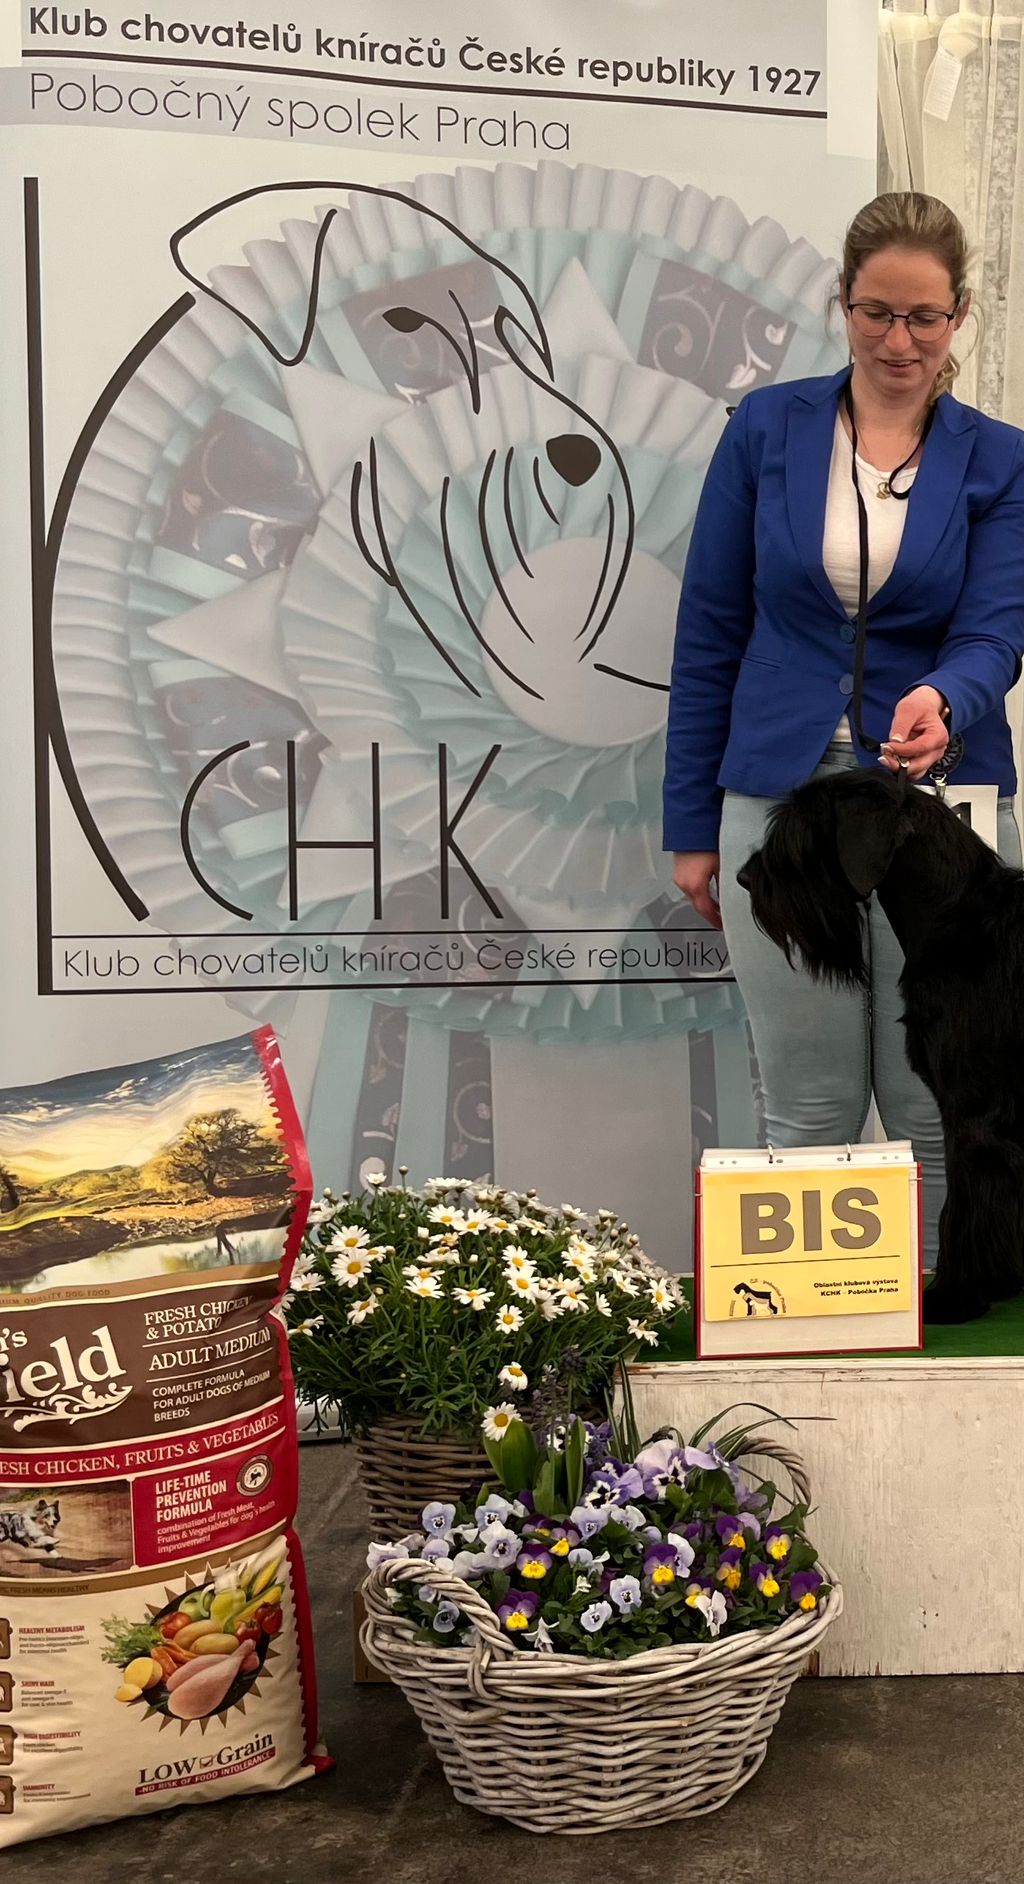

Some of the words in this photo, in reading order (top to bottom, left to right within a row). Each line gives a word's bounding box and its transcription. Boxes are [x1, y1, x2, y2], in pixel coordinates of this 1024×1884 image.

[29, 6, 108, 38] Klub
[120, 13, 302, 54] chovatelů
[315, 28, 446, 68] kníračů
[458, 35, 567, 77] České
[577, 55, 736, 96] republiky
[747, 64, 822, 97] 1927
[29, 71, 251, 133] Pobočný
[266, 96, 421, 142] spolek
[436, 105, 571, 151] Praha
[64, 949, 140, 977] Klub
[153, 944, 330, 976] chovatelů
[342, 942, 465, 974] kníračů
[476, 938, 576, 971] České
[587, 941, 729, 974] republiky
[739, 1186, 882, 1256] BIS
[24, 1292, 62, 1305] QUALITY
[65, 1290, 84, 1298] DOG
[87, 1289, 111, 1297] FOOD
[820, 1289, 842, 1297] KCHK
[144, 1305, 197, 1326] FRESH
[146, 1326, 160, 1340] &
[148, 1346, 214, 1371] ADULT
[215, 1326, 272, 1359] MEDIUM
[152, 1380, 203, 1398] COMPLETE
[205, 1369, 246, 1387] FORMULA
[153, 1399, 174, 1410] FOR
[175, 1392, 205, 1407] ADULT
[206, 1384, 232, 1399] DOGS
[232, 1381, 243, 1392] OF
[244, 1370, 271, 1387] MEDIUM
[153, 1407, 191, 1423] BREEDS
[34, 1455, 121, 1475] CHICKEN,
[125, 1443, 184, 1467] FRUITS
[187, 1439, 200, 1455] &
[203, 1413, 279, 1451] VEGETABLES
[155, 1470, 211, 1495] LIFE-TIME
[156, 1480, 227, 1509] PREVENTION
[156, 1498, 213, 1523] FORMULA
[157, 1516, 207, 1535] combination
[208, 1513, 217, 1523] of
[217, 1508, 236, 1520] Fresh
[157, 1532, 180, 1544] Fruits
[181, 1530, 188, 1539] &
[189, 1520, 229, 1538] Vegetables
[230, 1515, 240, 1524] for
[157, 1535, 211, 1553] improvement
[138, 1756, 198, 1785] LOW
[217, 1733, 274, 1766] Grain
[158, 1781, 178, 1789] RISK
[180, 1778, 191, 1786] OF
[195, 1772, 218, 1783] FOOD
